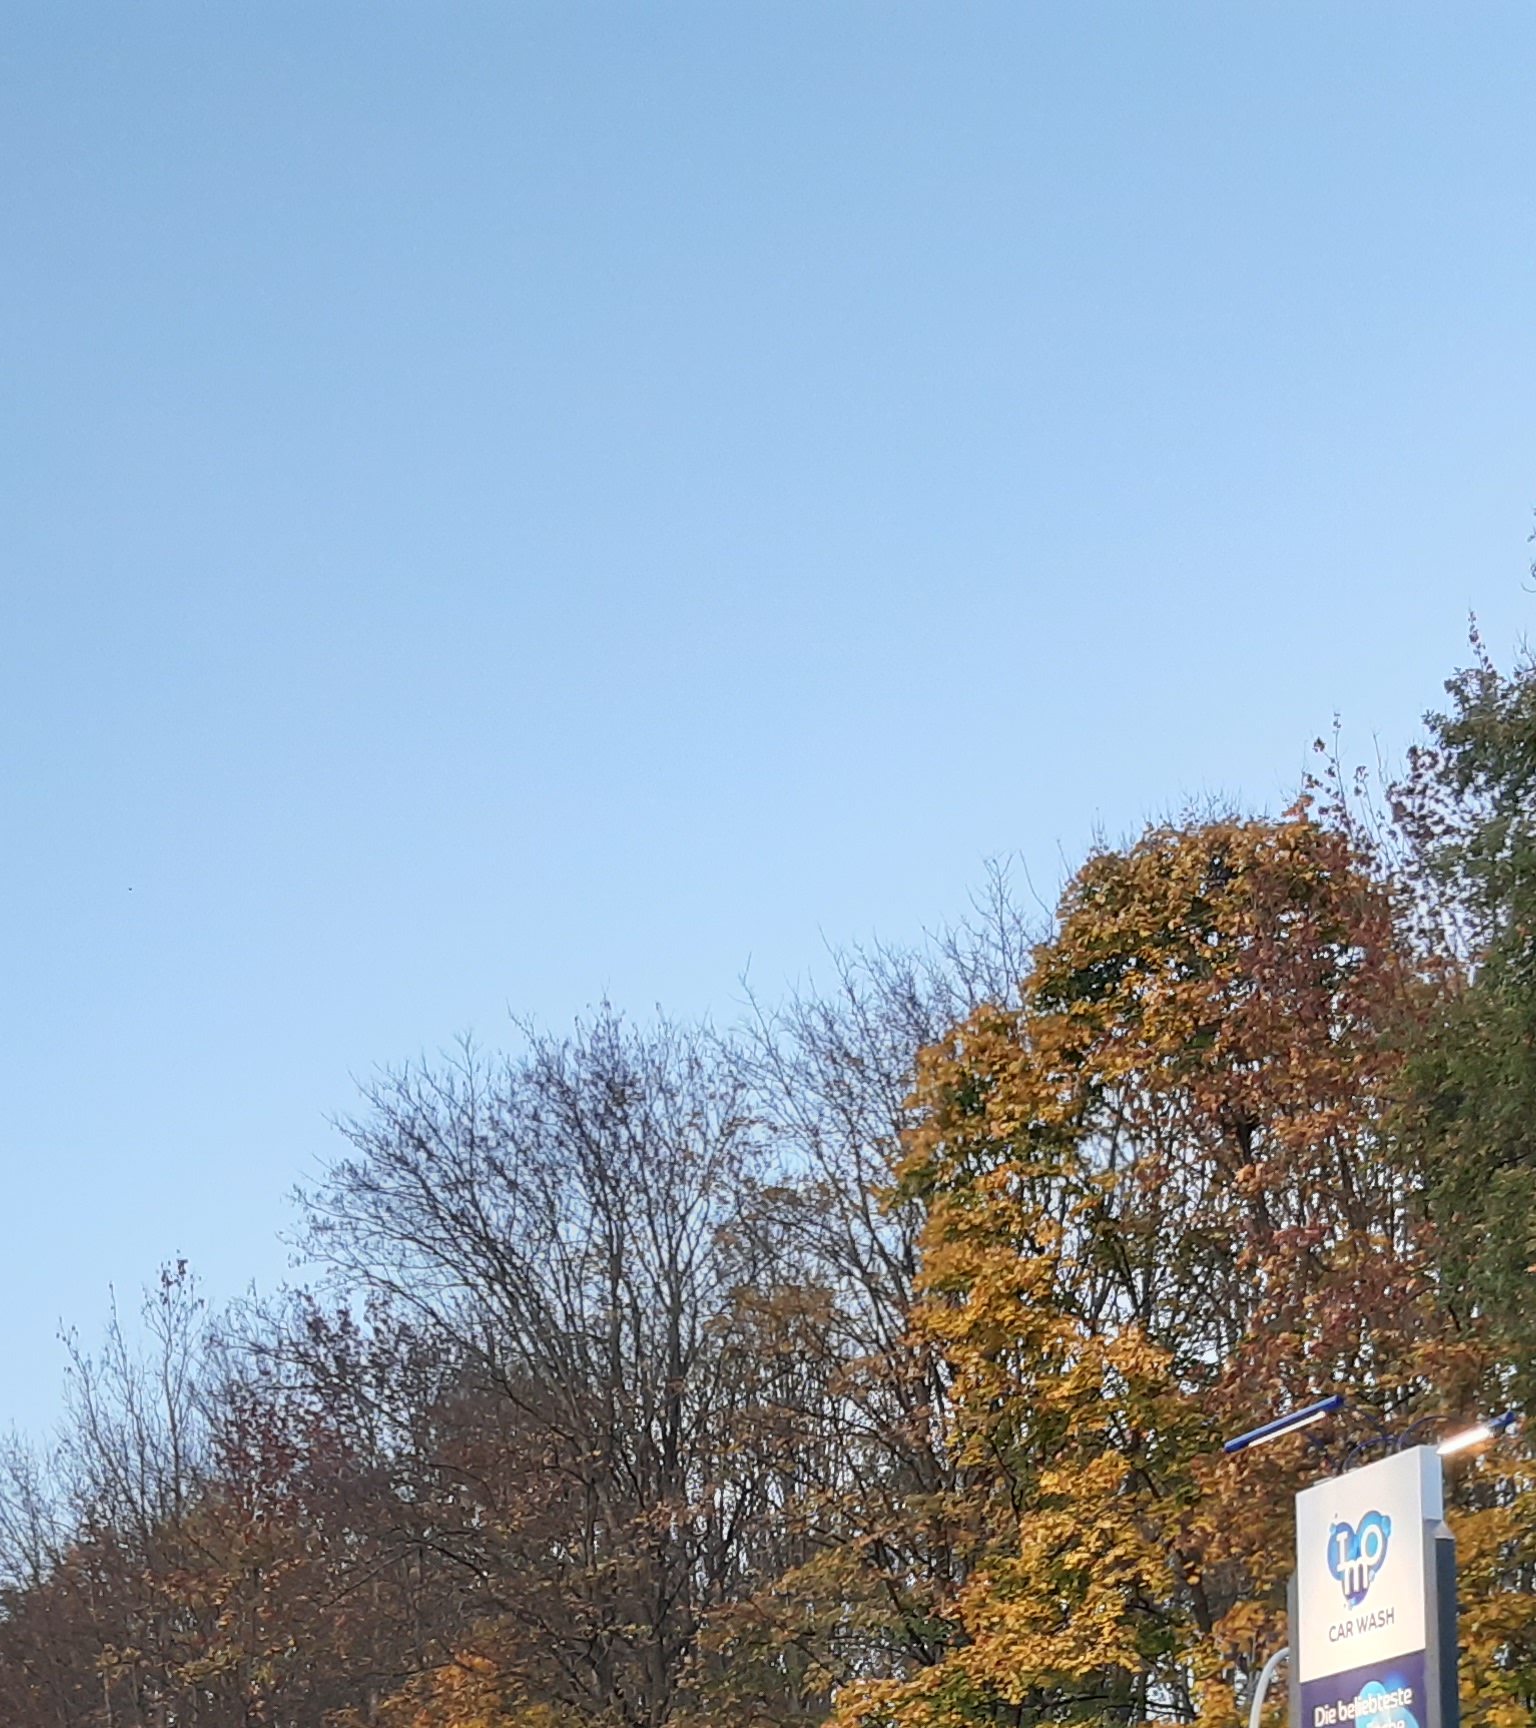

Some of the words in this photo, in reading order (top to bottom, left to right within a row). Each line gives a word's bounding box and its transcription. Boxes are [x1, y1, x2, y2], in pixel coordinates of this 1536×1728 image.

[1328, 1620, 1354, 1643] CAR
[1356, 1606, 1395, 1635] WASH
[1314, 1703, 1337, 1728] Die
